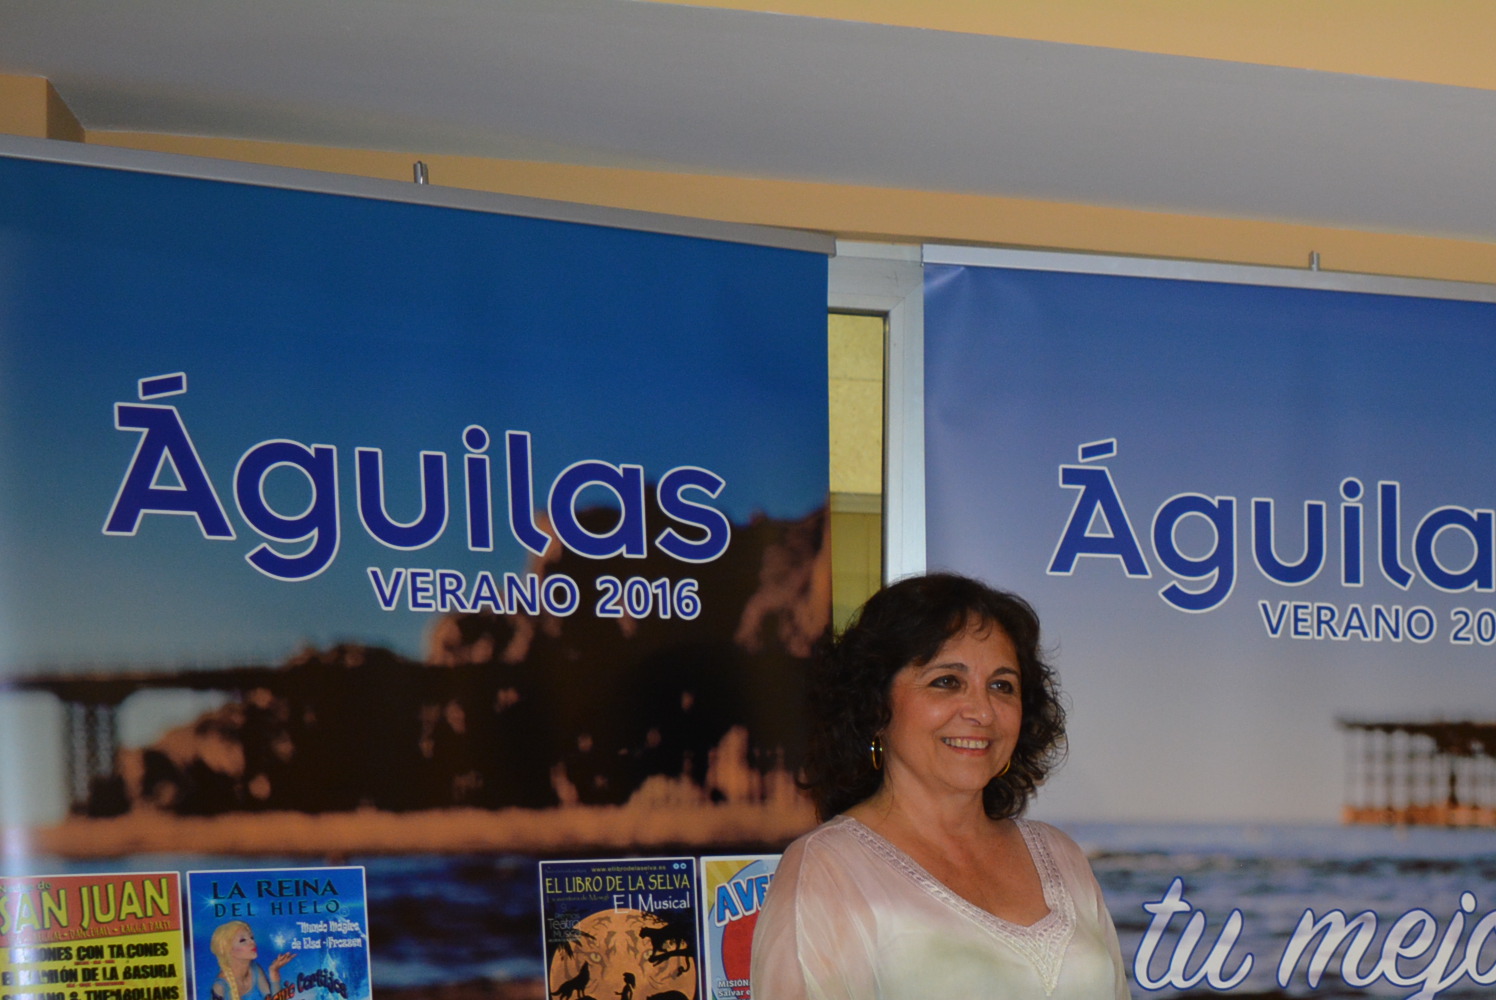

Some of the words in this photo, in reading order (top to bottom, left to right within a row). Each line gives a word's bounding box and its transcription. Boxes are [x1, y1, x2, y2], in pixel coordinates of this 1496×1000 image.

[102, 371, 732, 582] Águilas
[367, 567, 580, 617] VERANO
[595, 576, 701, 621] 2016
[1259, 601, 1436, 642] VERANO
[212, 881, 245, 899] LA
[257, 879, 339, 898] REINA
[546, 878, 563, 893] EL
[566, 876, 602, 892] LIBRO
[606, 876, 623, 891] DE
[628, 875, 645, 890] LA
[648, 873, 690, 890] SELVA
[639, 892, 690, 912] Musical
[81, 878, 170, 931] JUAN
[214, 903, 255, 918] DEL
[270, 900, 341, 915] HIELO
[1134, 876, 1254, 991] tu
